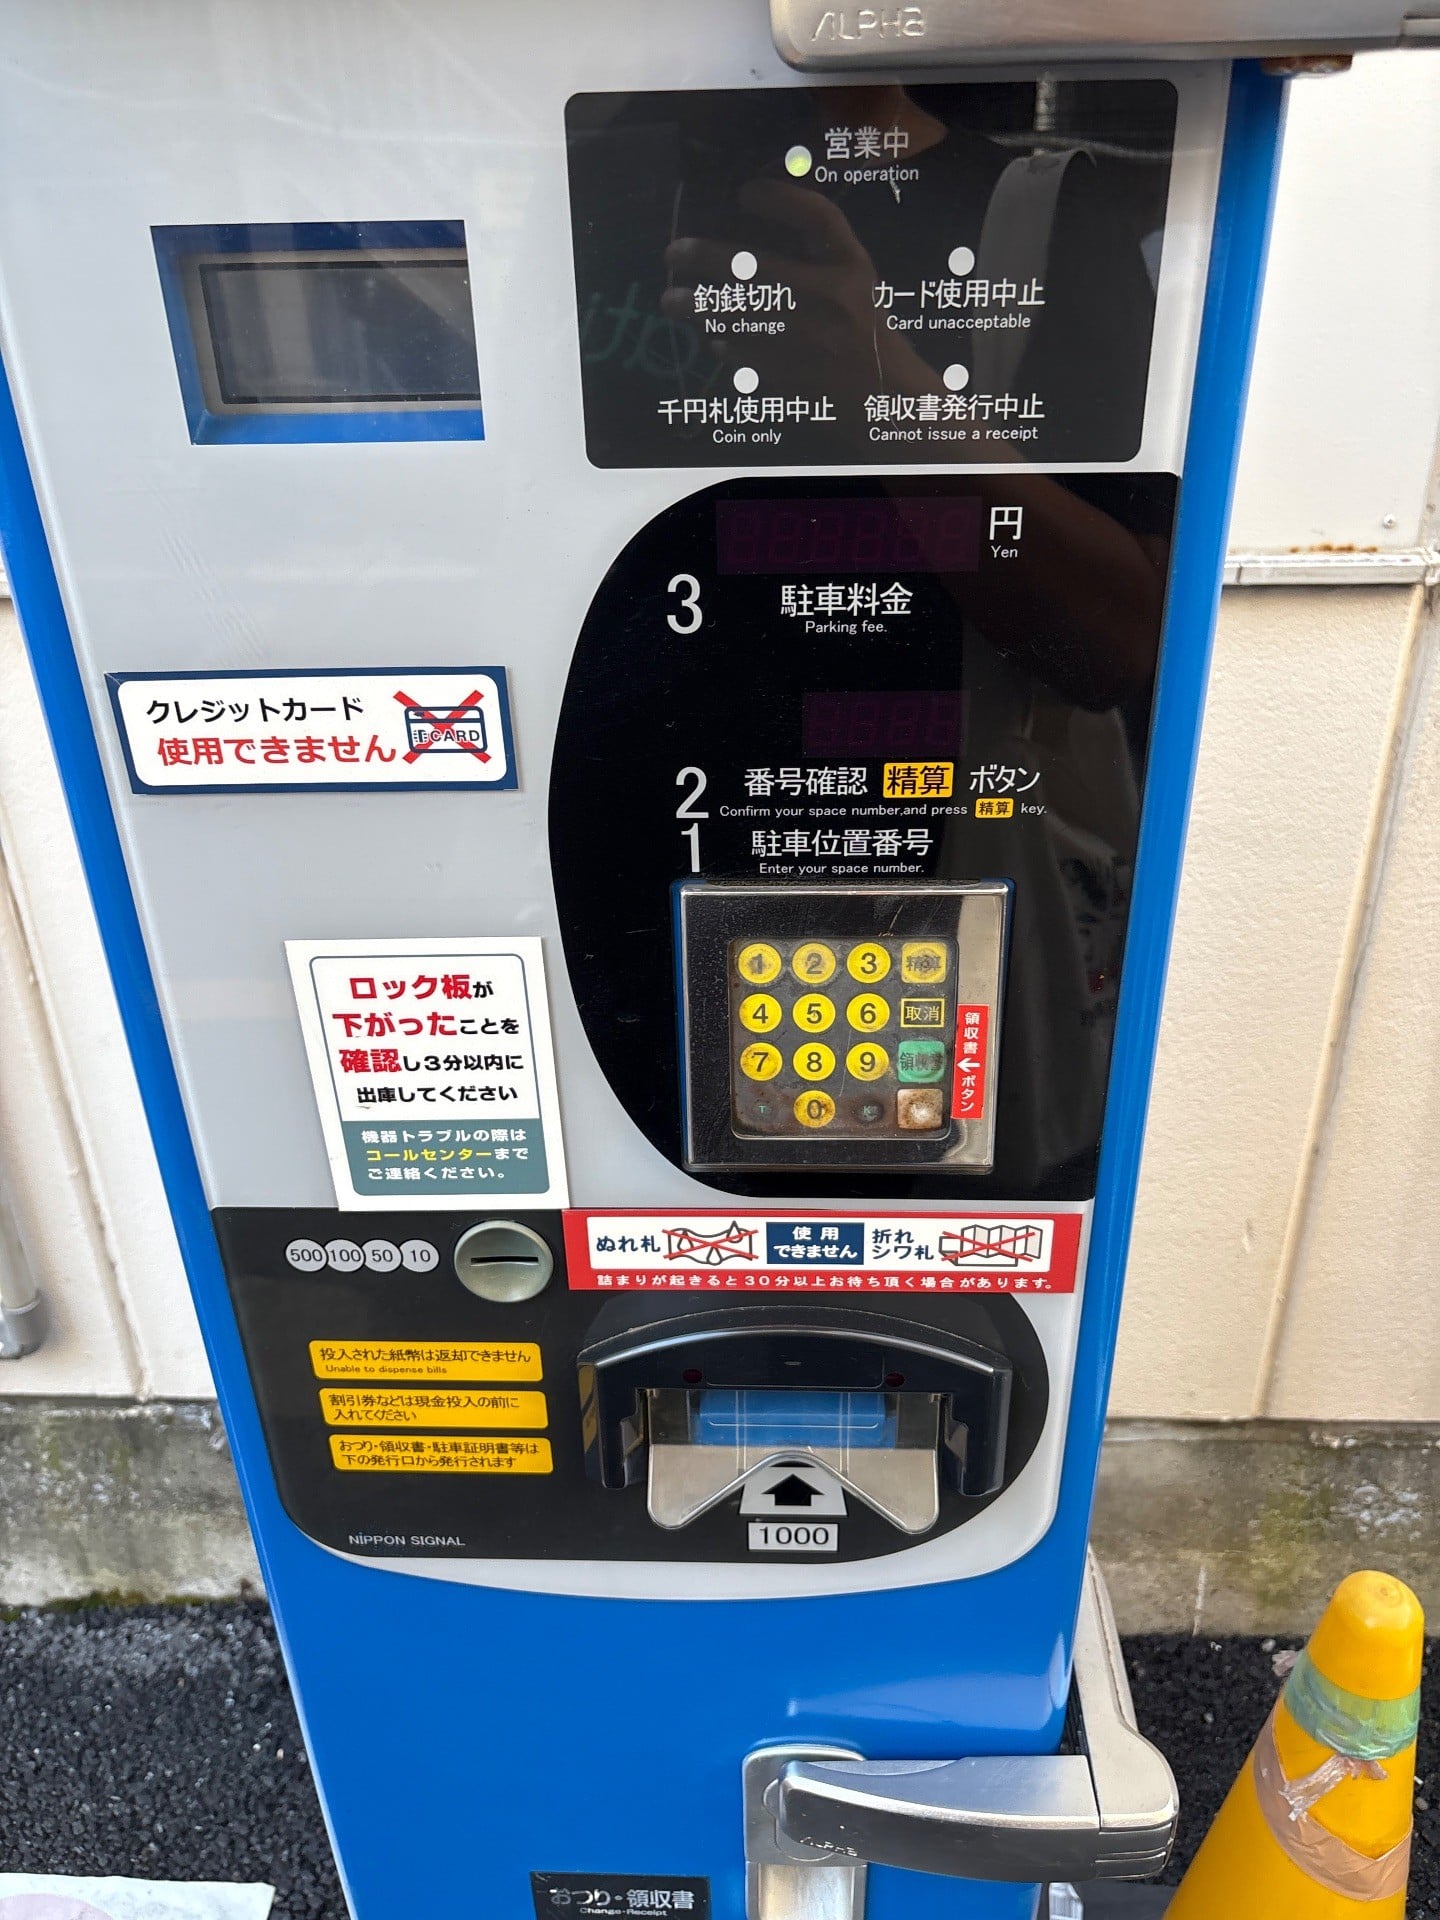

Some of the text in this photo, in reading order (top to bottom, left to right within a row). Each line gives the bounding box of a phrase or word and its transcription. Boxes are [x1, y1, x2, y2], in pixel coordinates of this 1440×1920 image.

[825, 127, 910, 160] 営業中
[814, 165, 919, 184] On operation
[694, 283, 796, 313] 釣銭切れ
[873, 278, 1046, 309] カード使用中止
[705, 318, 785, 335] No change
[886, 312, 1031, 332] Card unacceptable
[657, 397, 837, 425] 千円札使用中止
[864, 393, 1046, 422] 領収書発行中止
[712, 428, 782, 447] Coin only
[868, 425, 1039, 444] Cannot issue a receipt
[988, 506, 1024, 541] 円
[991, 545, 1018, 559] Yen
[666, 573, 703, 634] 3
[780, 582, 914, 617] 駐車料金
[805, 620, 888, 635] Parking fee.
[146, 696, 365, 724] クレジットカード
[157, 734, 397, 766] 使用できません
[743, 764, 1041, 797] 番号確認 精算 ボタン
[675, 766, 709, 819] 2
[719, 804, 771, 818] Confirm
[775, 806, 804, 819] your
[808, 806, 847, 819] space
[931, 804, 968, 819] press
[978, 800, 1011, 817] 精算
[1020, 802, 1048, 817] key.
[681, 822, 701, 873] 1
[751, 828, 934, 858] 駐車位置番号
[759, 861, 925, 877] Enter your space number.
[750, 953, 765, 975] 1
[805, 953, 823, 975] 2
[860, 952, 877, 974] 3
[349, 974, 494, 1000] ロック板が
[752, 1003, 768, 1024] 4
[806, 1003, 822, 1024] 5
[860, 1003, 877, 1023] 6
[905, 1005, 939, 1021] 取消
[332, 1011, 519, 1037] 下がったことを
[339, 1048, 524, 1073] 確認し3分以内に
[752, 1052, 769, 1072] 7
[806, 1052, 823, 1072] 8
[859, 1052, 875, 1072] 9
[960, 1011, 980, 1112] 領収書 ボタン
[356, 1085, 518, 1104] 出庫してください
[807, 1099, 823, 1120] 0
[361, 1128, 527, 1144] 機器トラブルの際は
[366, 1147, 528, 1161] コールセンターまで
[367, 1166, 505, 1180] ご連絡ください。
[596, 1235, 661, 1253] ぬれ札
[872, 1228, 914, 1244] 折れ
[290, 1248, 431, 1264] 500 100 50 10
[773, 1243, 858, 1260] できません
[872, 1243, 934, 1261] シワ札
[320, 1347, 532, 1363] 投入された紙幣は返却できません
[326, 1365, 447, 1375] Unable to dispense bills
[329, 1394, 521, 1408] 割引券などは現金投入の前に
[334, 1409, 417, 1421] 入れてください
[349, 1533, 466, 1546] NIPPON SIGNAL
[759, 1525, 830, 1546] 1000
